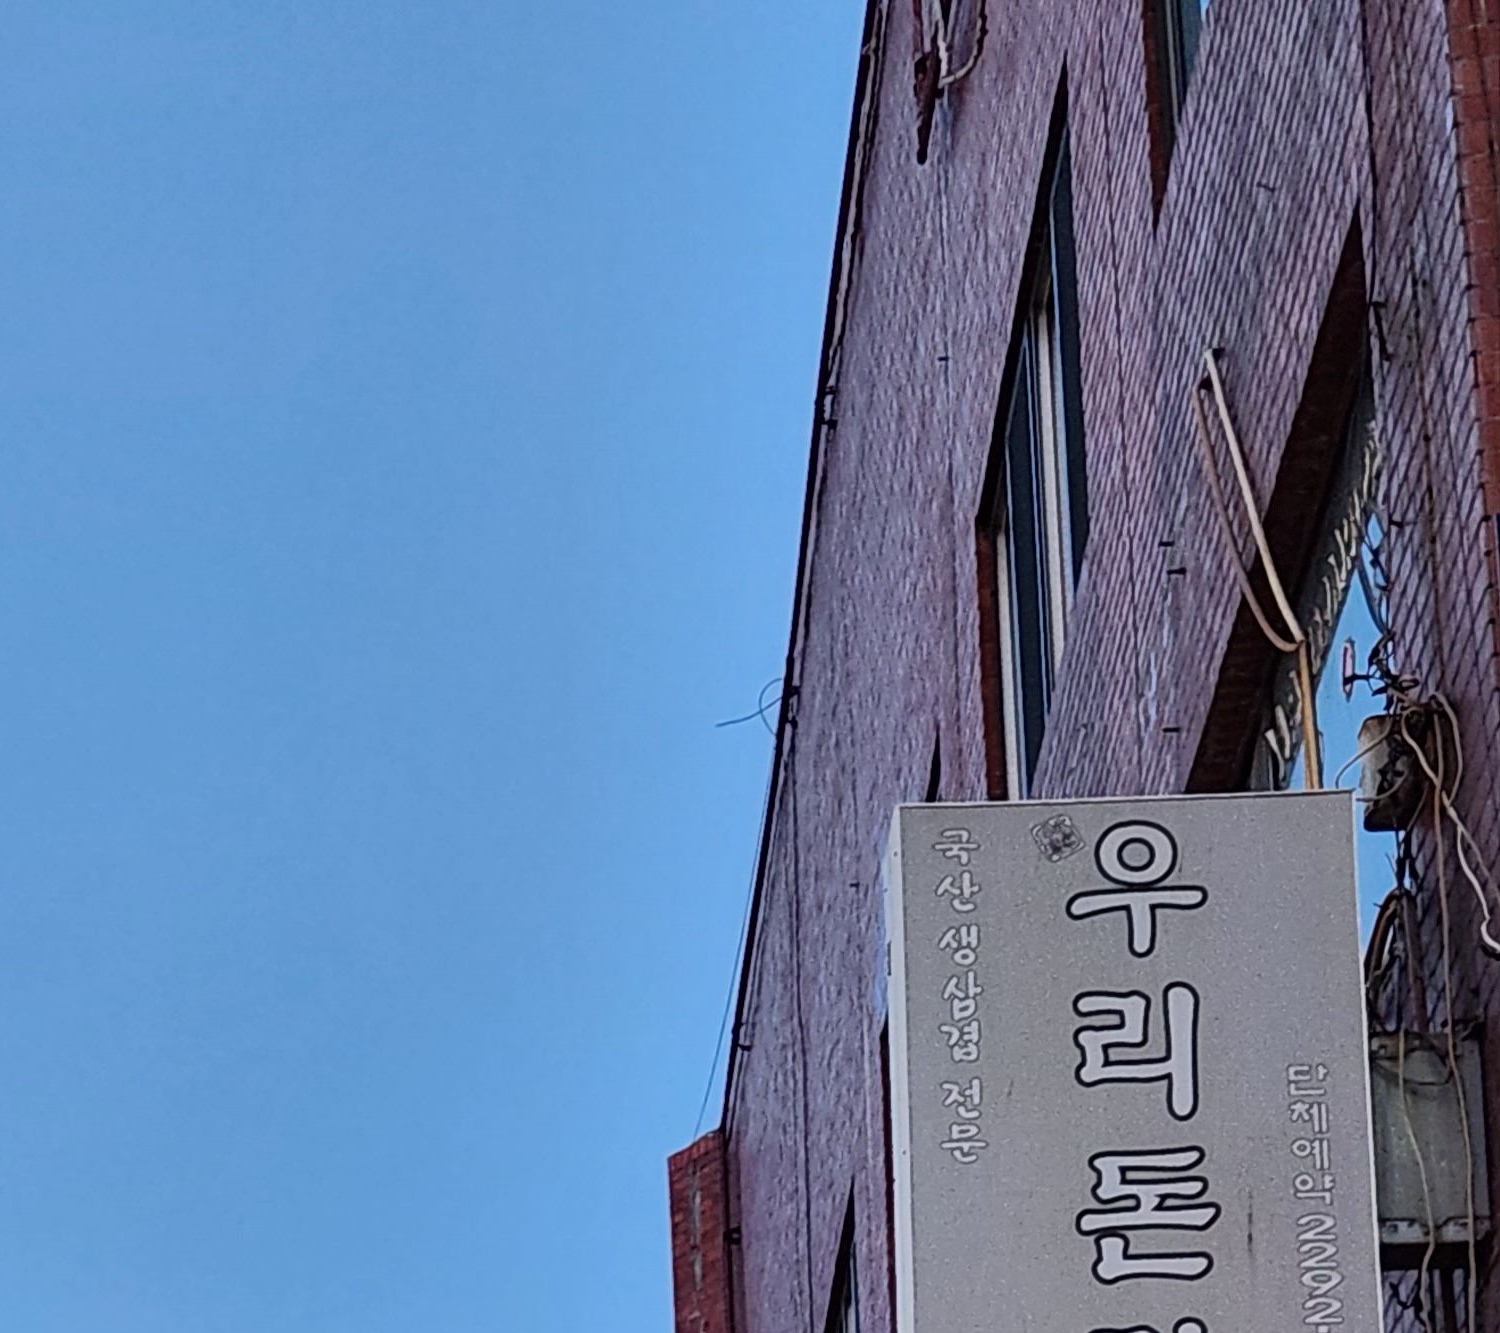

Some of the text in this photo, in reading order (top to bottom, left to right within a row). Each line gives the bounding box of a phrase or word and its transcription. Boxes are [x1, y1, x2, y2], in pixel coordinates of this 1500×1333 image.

[933, 826, 988, 1164] 국산 생삼겹 전문
